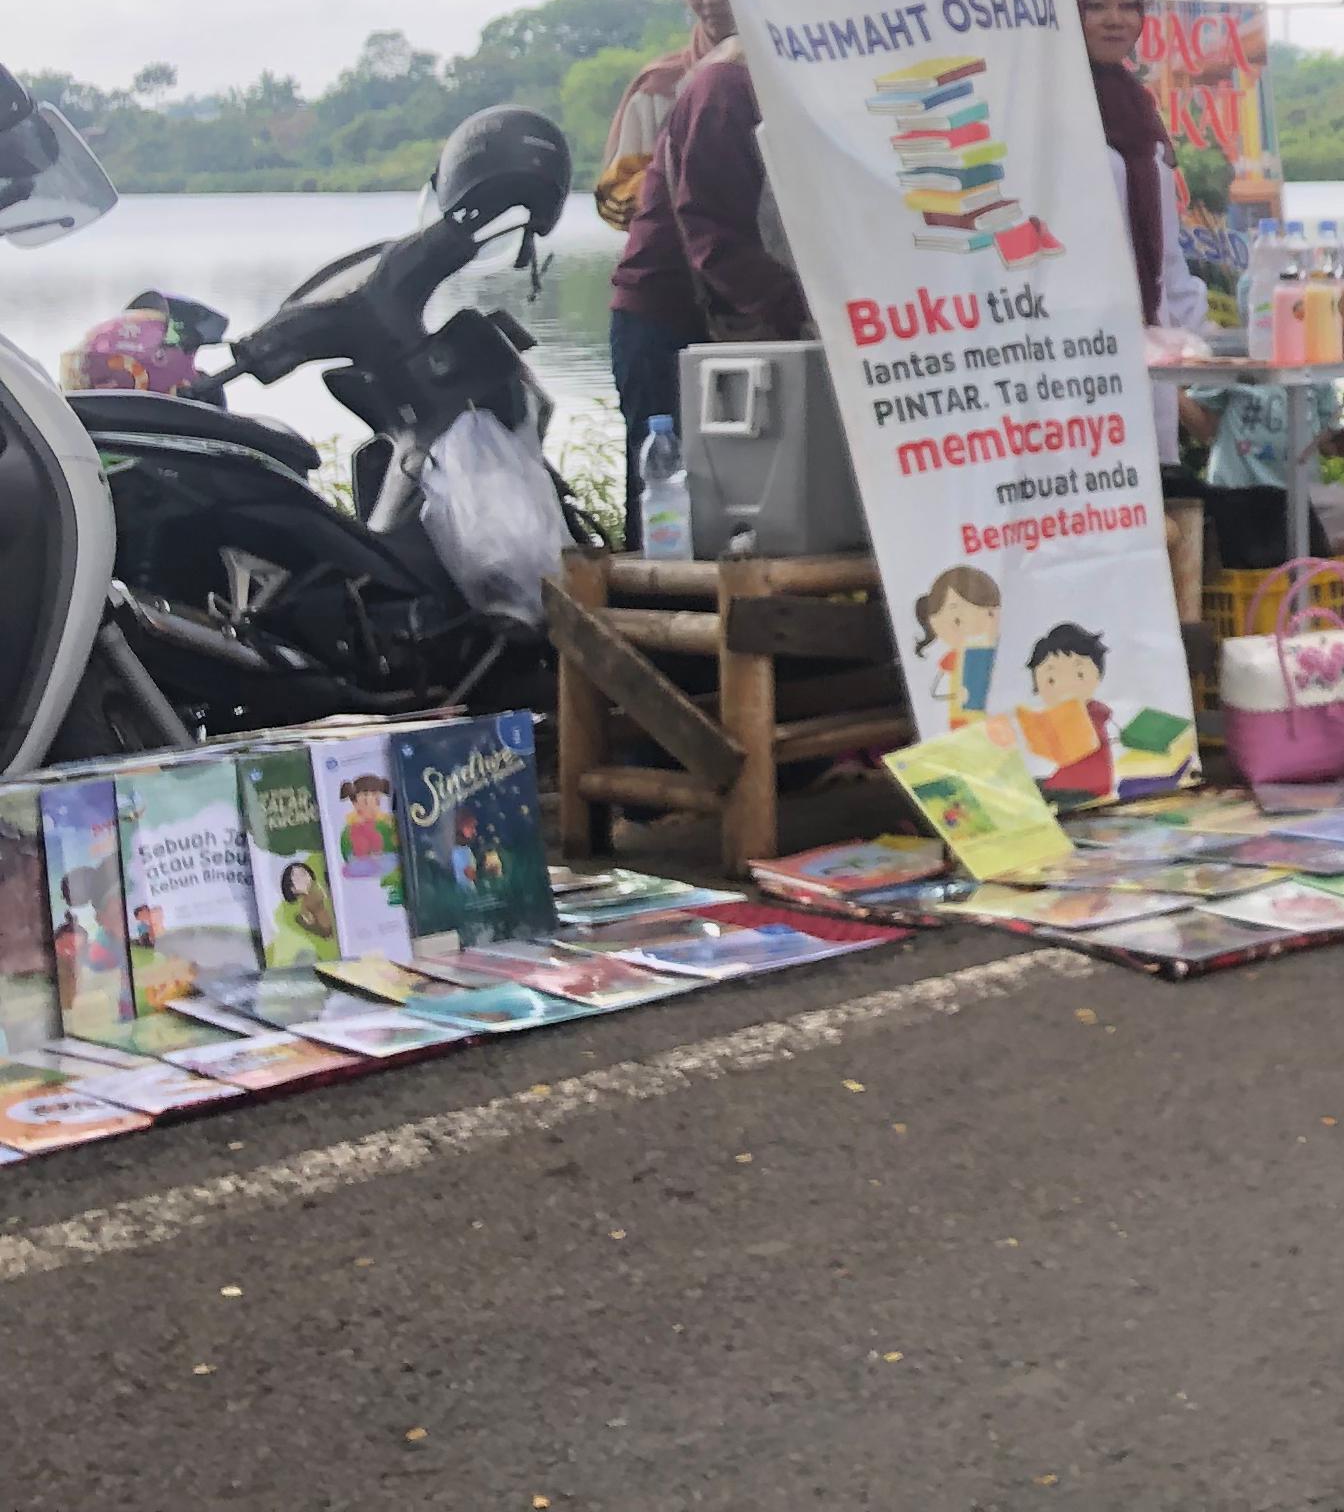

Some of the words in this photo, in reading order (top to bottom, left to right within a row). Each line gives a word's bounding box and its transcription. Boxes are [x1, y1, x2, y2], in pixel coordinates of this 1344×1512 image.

[766, 3, 932, 64] RAHMAHT
[846, 287, 981, 347] Buku
[863, 351, 956, 387] lantas
[1063, 328, 1119, 359] anda
[873, 384, 990, 427] PINTAR.
[994, 379, 1029, 405] Ta
[1036, 372, 1123, 404] dengan
[1085, 460, 1139, 492] anda
[146, 853, 194, 880] atau
